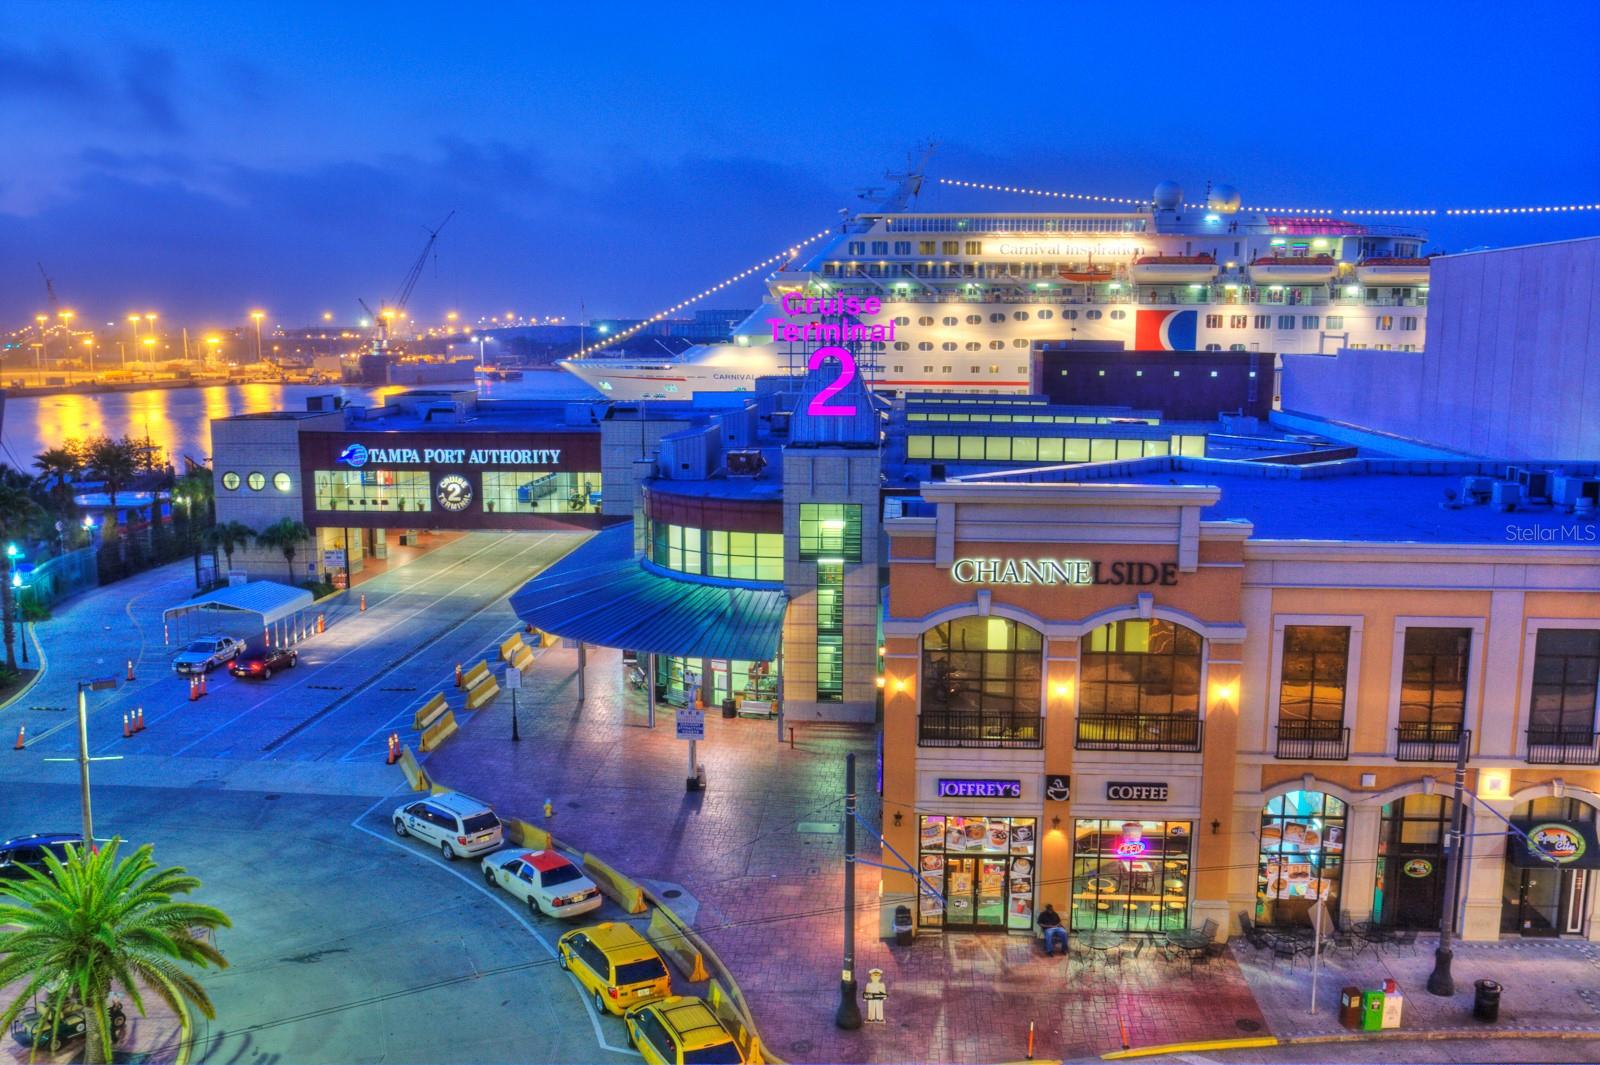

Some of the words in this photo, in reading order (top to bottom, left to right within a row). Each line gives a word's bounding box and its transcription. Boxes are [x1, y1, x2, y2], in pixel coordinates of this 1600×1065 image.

[1000, 243, 1060, 255] Carnival
[782, 291, 881, 315] Cruise
[767, 318, 896, 342] Terminal
[713, 373, 756, 381] CARNIVAL
[808, 347, 857, 416] 2
[368, 449, 420, 463] TAMPA
[424, 449, 466, 464] PORT
[469, 449, 561, 464] AUTHORITY
[440, 475, 468, 488] CRUISE
[447, 483, 462, 502] 2
[438, 492, 471, 511] TERMINAL
[952, 558, 1179, 587] CHANNELSIDE
[940, 782, 1020, 798] JOFFREY'S
[1108, 786, 1168, 799] COFFEE
[1119, 843, 1142, 854] OPEN
